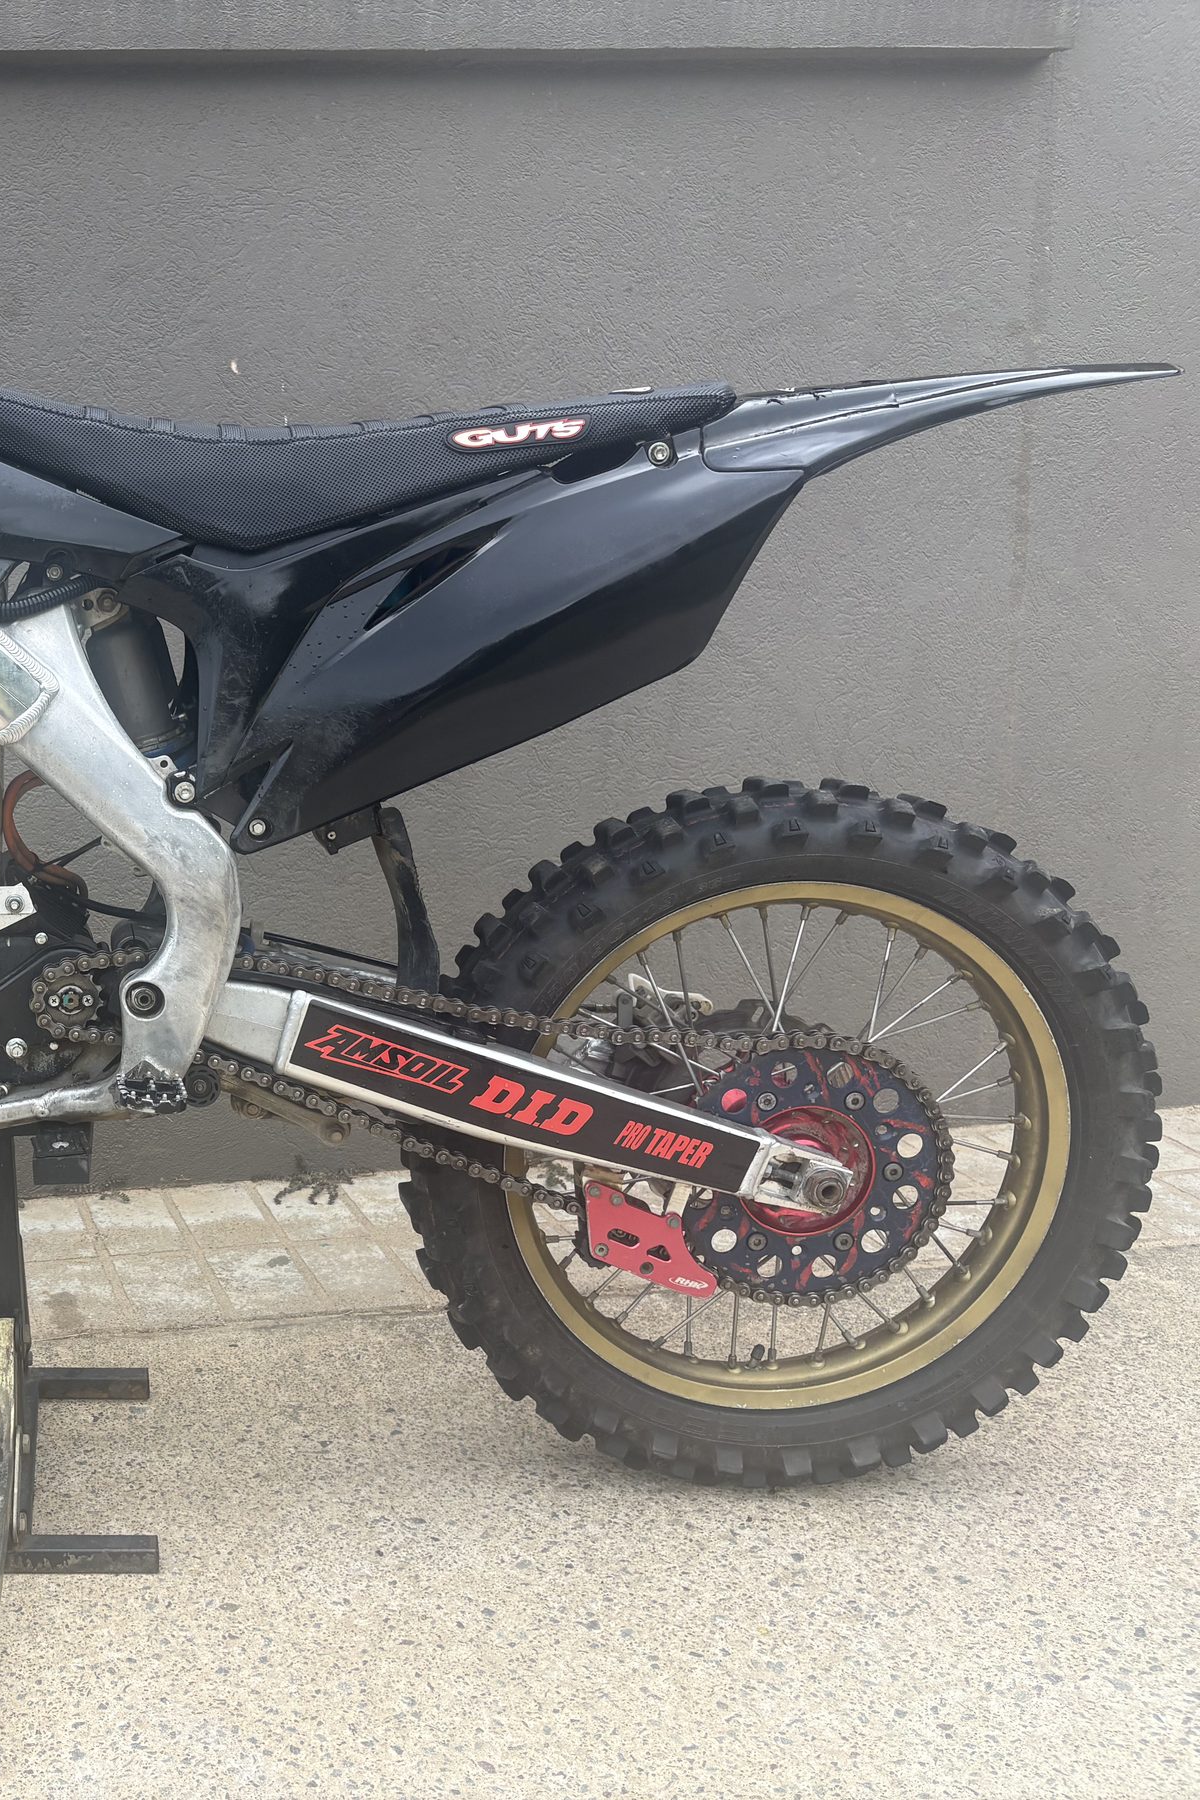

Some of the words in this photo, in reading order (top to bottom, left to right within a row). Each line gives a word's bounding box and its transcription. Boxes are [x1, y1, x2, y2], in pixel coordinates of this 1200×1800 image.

[452, 418, 586, 448] GUTS
[305, 1024, 470, 1095] AMSOIL
[614, 1120, 646, 1152] PRO
[644, 1128, 714, 1169] TAPER
